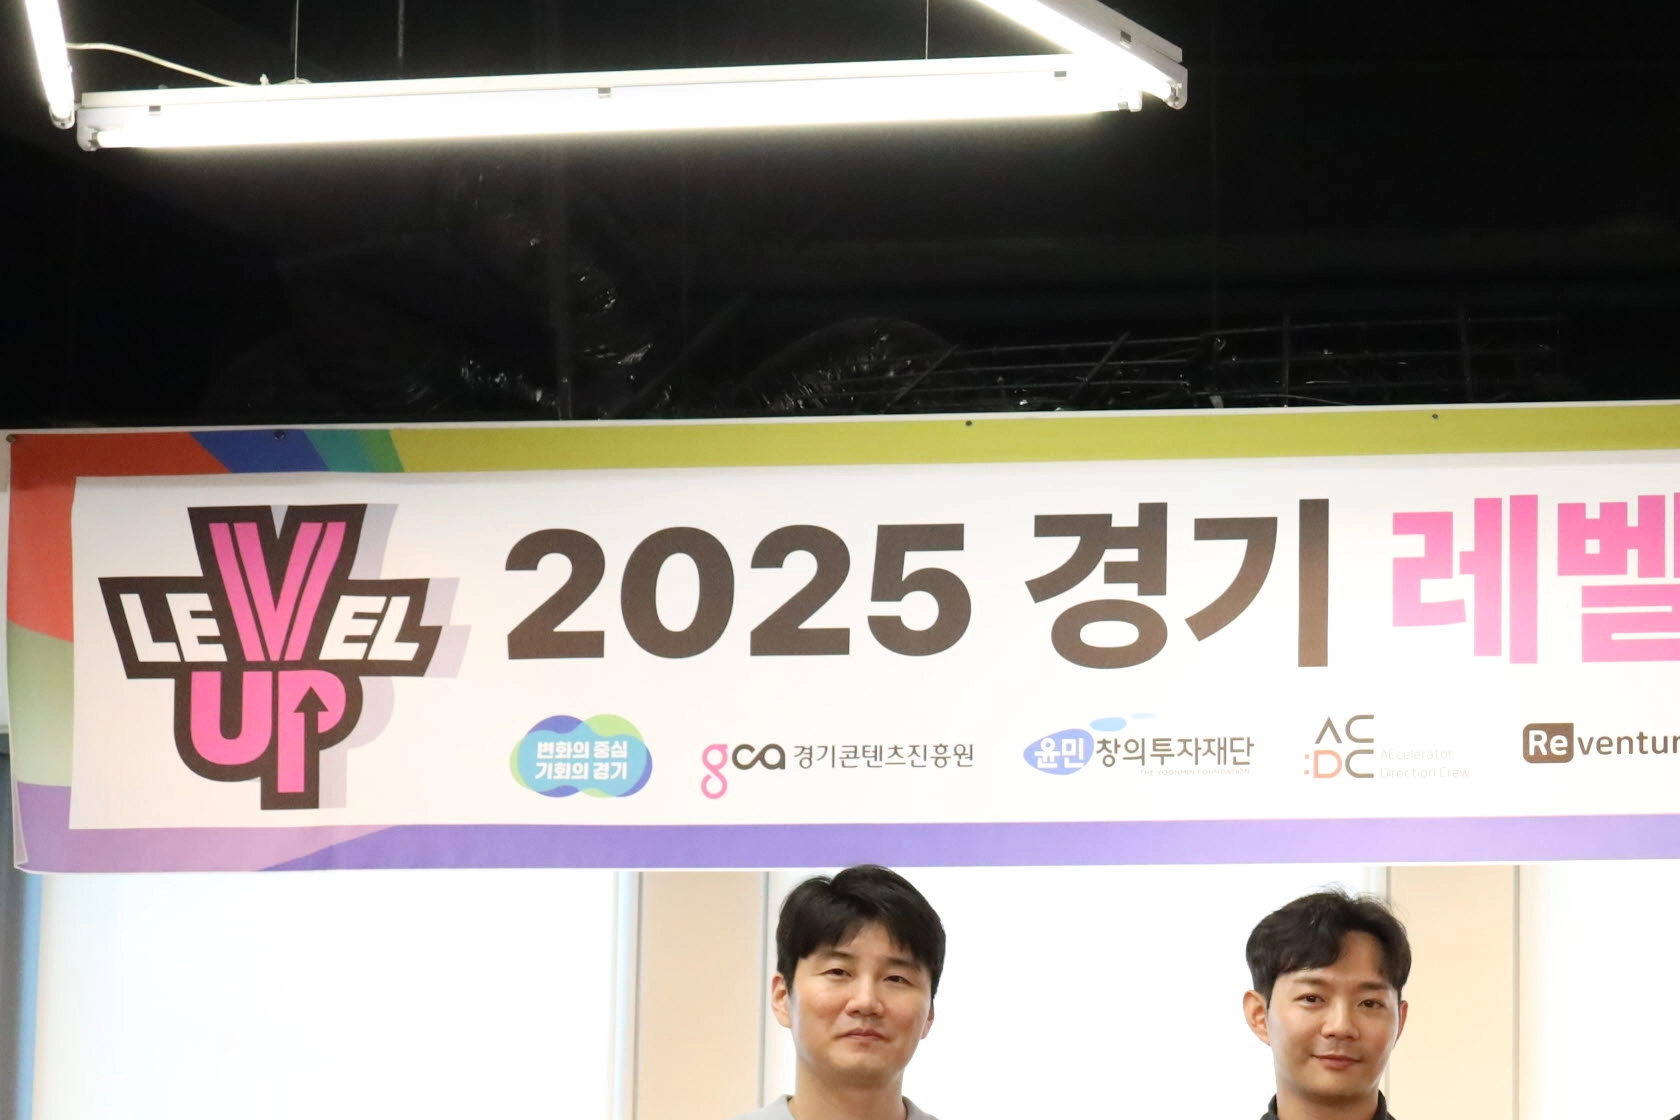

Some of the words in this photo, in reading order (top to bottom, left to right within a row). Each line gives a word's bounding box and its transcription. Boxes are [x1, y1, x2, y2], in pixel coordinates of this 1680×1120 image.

[118, 521, 420, 662] LEVEL
[505, 522, 972, 660] 2025
[1024, 498, 1330, 669] 경기
[189, 669, 348, 793] UP
[536, 740, 590, 759] 변화의
[593, 740, 628, 759] 중심
[534, 762, 590, 780] 기회의
[592, 762, 628, 780] 경기
[701, 743, 786, 799] gca
[793, 743, 975, 769] 경기콘텐츠진흥원
[1380, 767, 1436, 779] Direction
[1439, 767, 1471, 779] Crew
